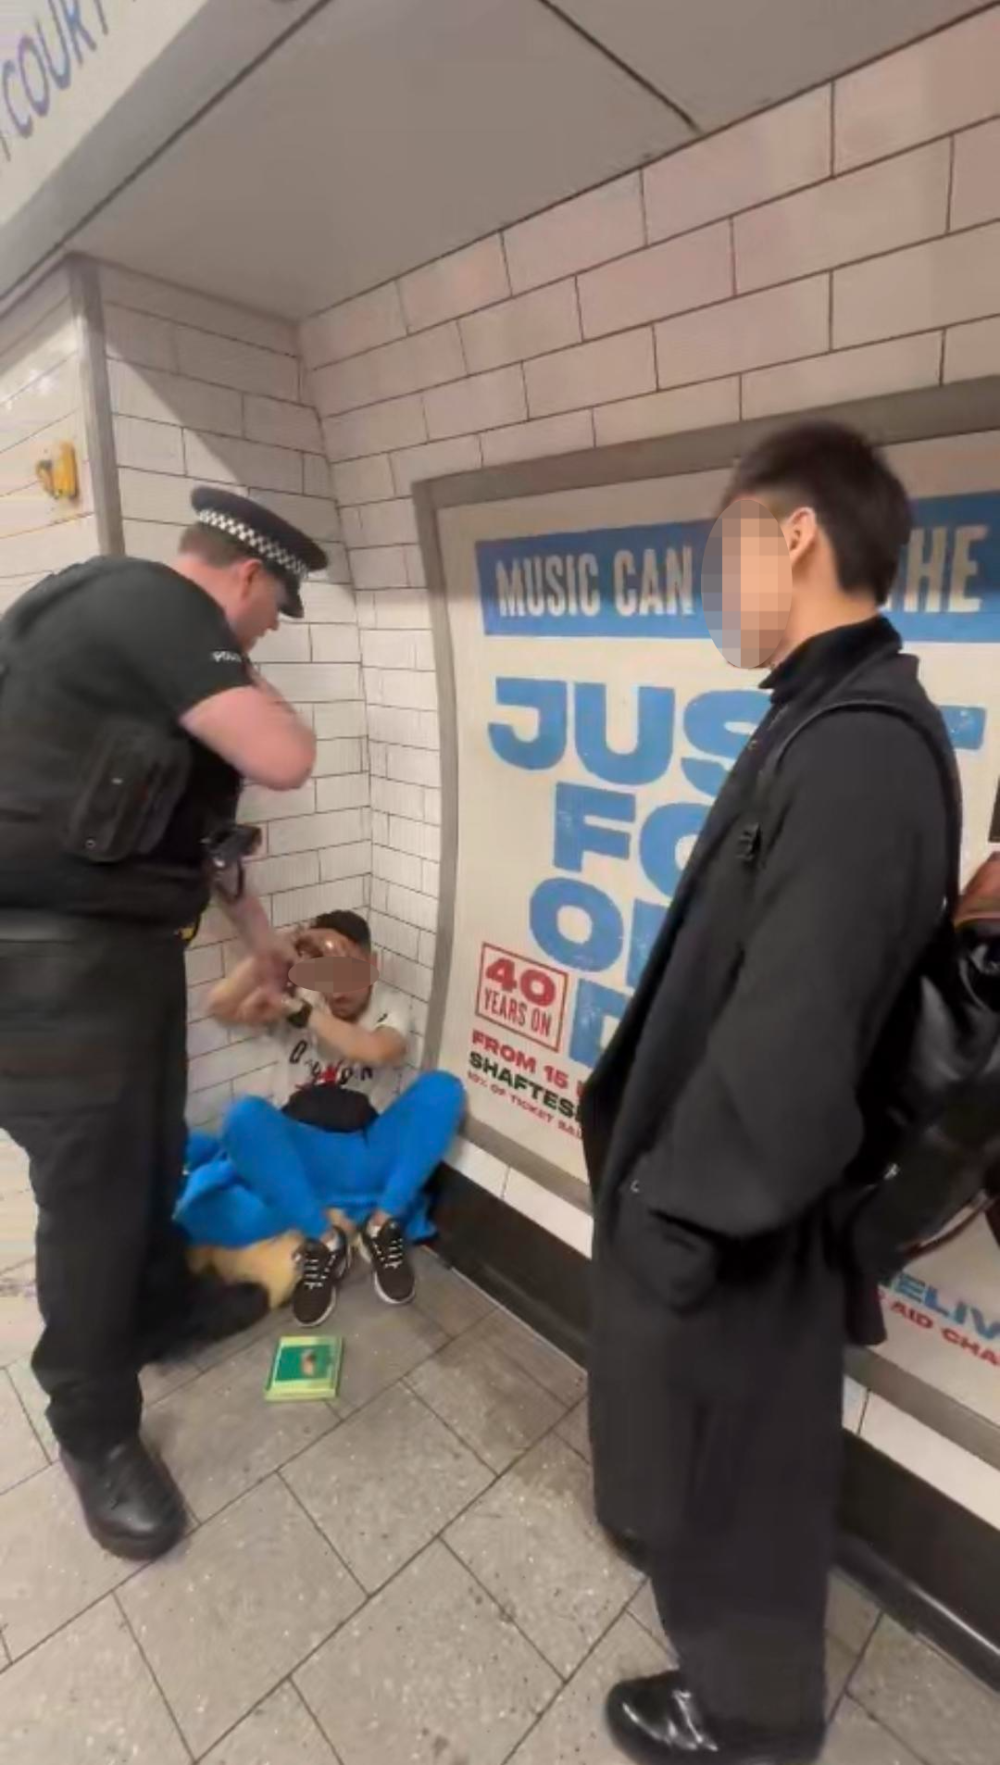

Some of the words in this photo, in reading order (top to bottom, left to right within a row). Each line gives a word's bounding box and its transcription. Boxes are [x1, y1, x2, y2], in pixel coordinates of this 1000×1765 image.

[496, 553, 601, 617] MUSIC
[613, 545, 695, 617] CAN
[884, 524, 989, 613] HE
[485, 956, 556, 1007] 40
[484, 986, 528, 1027] YEARS
[530, 1007, 552, 1037] ON
[472, 1029, 537, 1074] FROM
[543, 1064, 570, 1089] 15
[509, 1093, 554, 1124] TICKET
[890, 1300, 933, 1330] AID
[941, 1327, 1000, 1367] CHA
